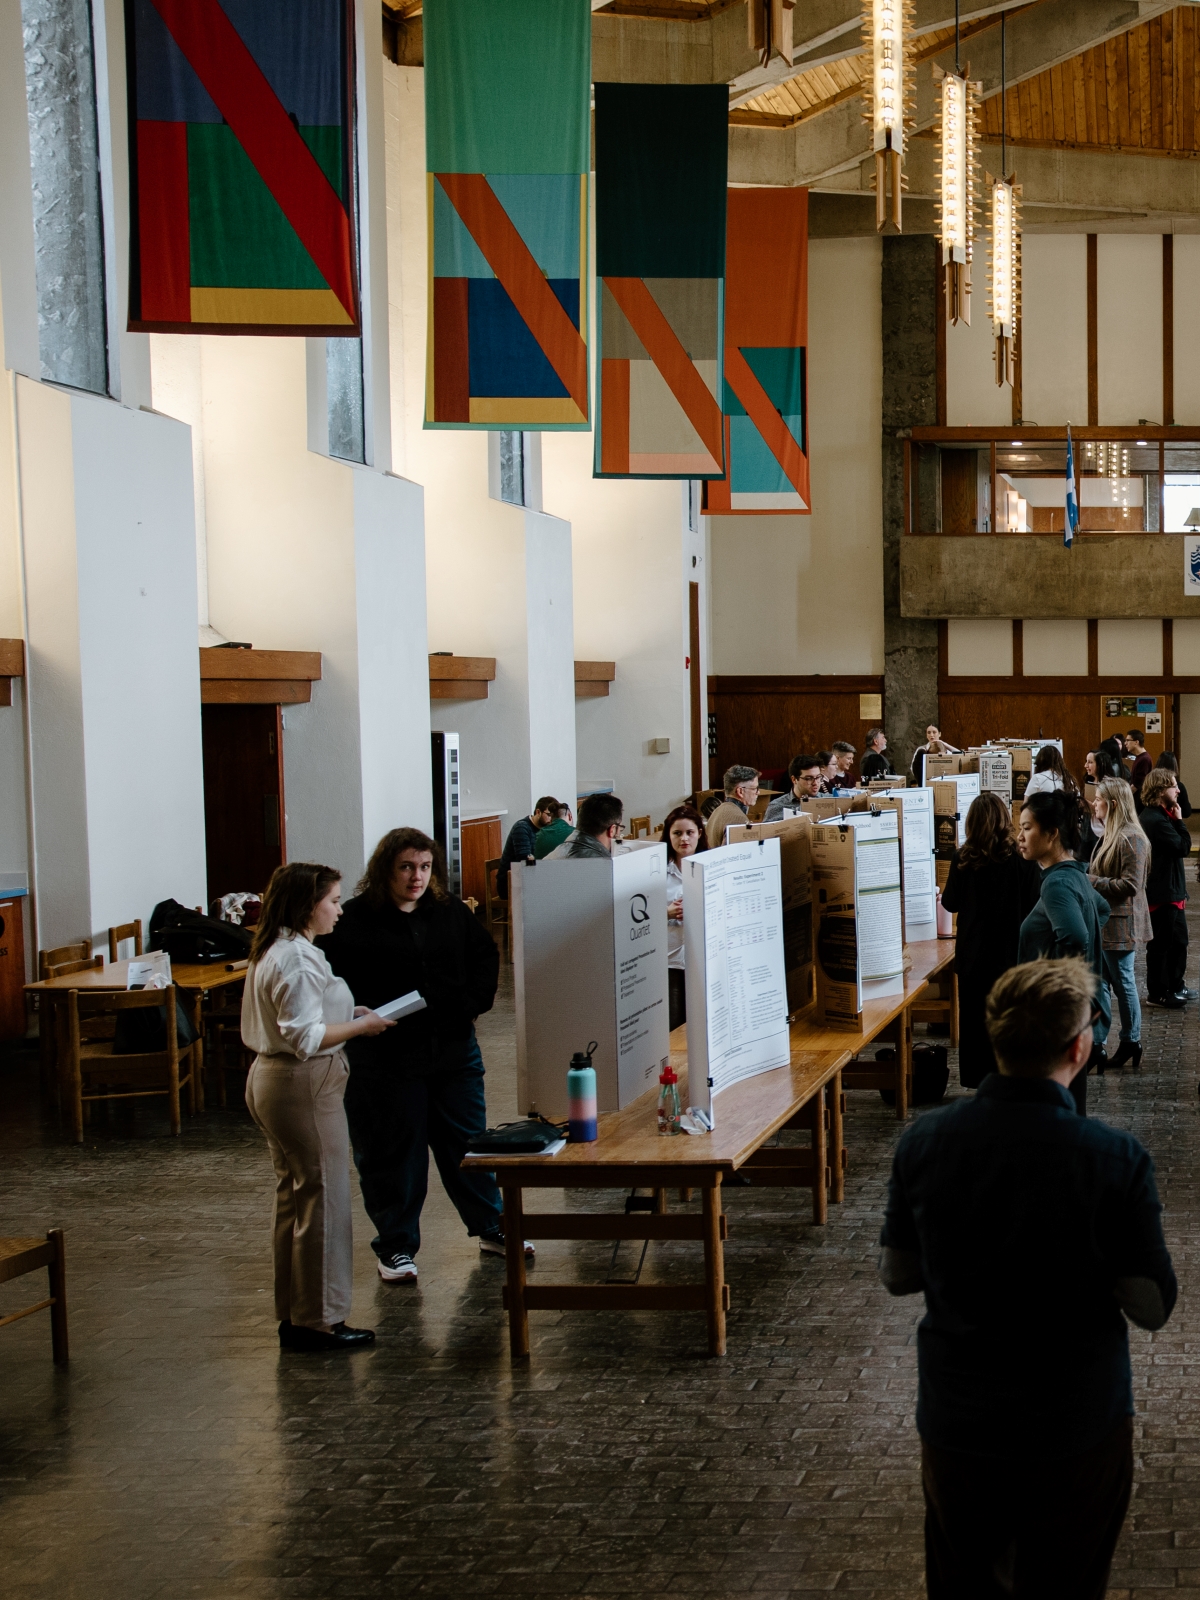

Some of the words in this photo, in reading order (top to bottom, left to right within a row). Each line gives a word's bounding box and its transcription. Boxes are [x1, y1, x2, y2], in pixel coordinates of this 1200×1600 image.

[740, 853, 752, 861] Equal
[629, 894, 650, 923] Q
[630, 925, 650, 940] Quartet
